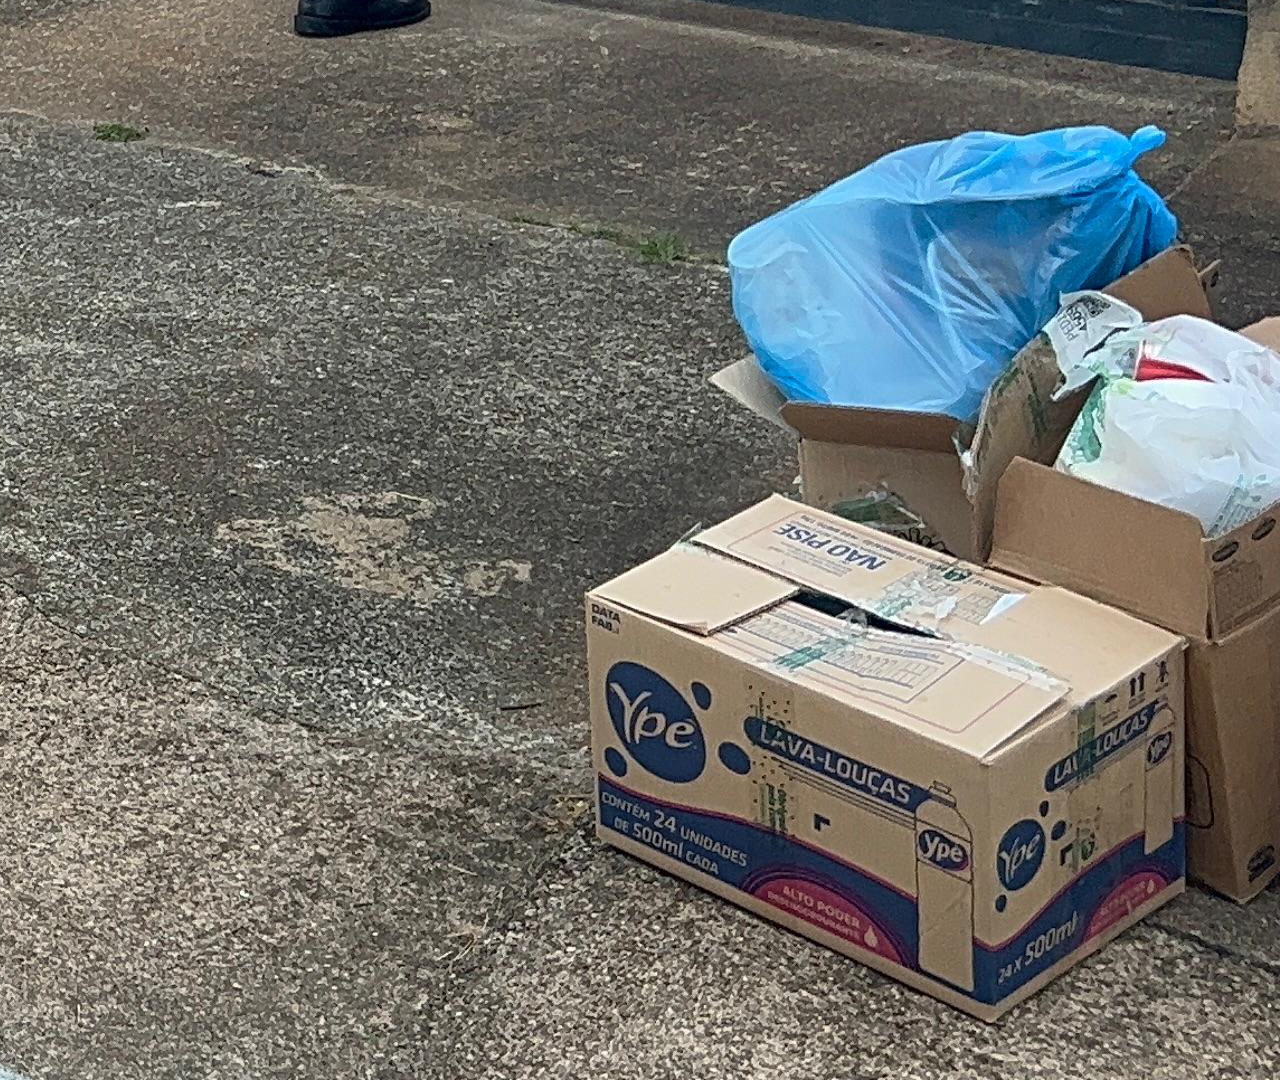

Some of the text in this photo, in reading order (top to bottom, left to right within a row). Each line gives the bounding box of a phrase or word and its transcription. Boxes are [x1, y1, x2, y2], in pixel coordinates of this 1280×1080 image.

[772, 522, 829, 551] PISE
[827, 544, 886, 571] NÃO
[591, 603, 621, 625] DATA
[759, 724, 912, 804] LAVA-LOUÇAS
[601, 791, 748, 867] CONTÉM 24 UNIDADES
[614, 816, 720, 875] DE 500ml CADA
[782, 885, 815, 908] ALTO
[816, 900, 860, 929] PODER
[997, 964, 1014, 986] 24
[1024, 910, 1081, 967] 500ml
